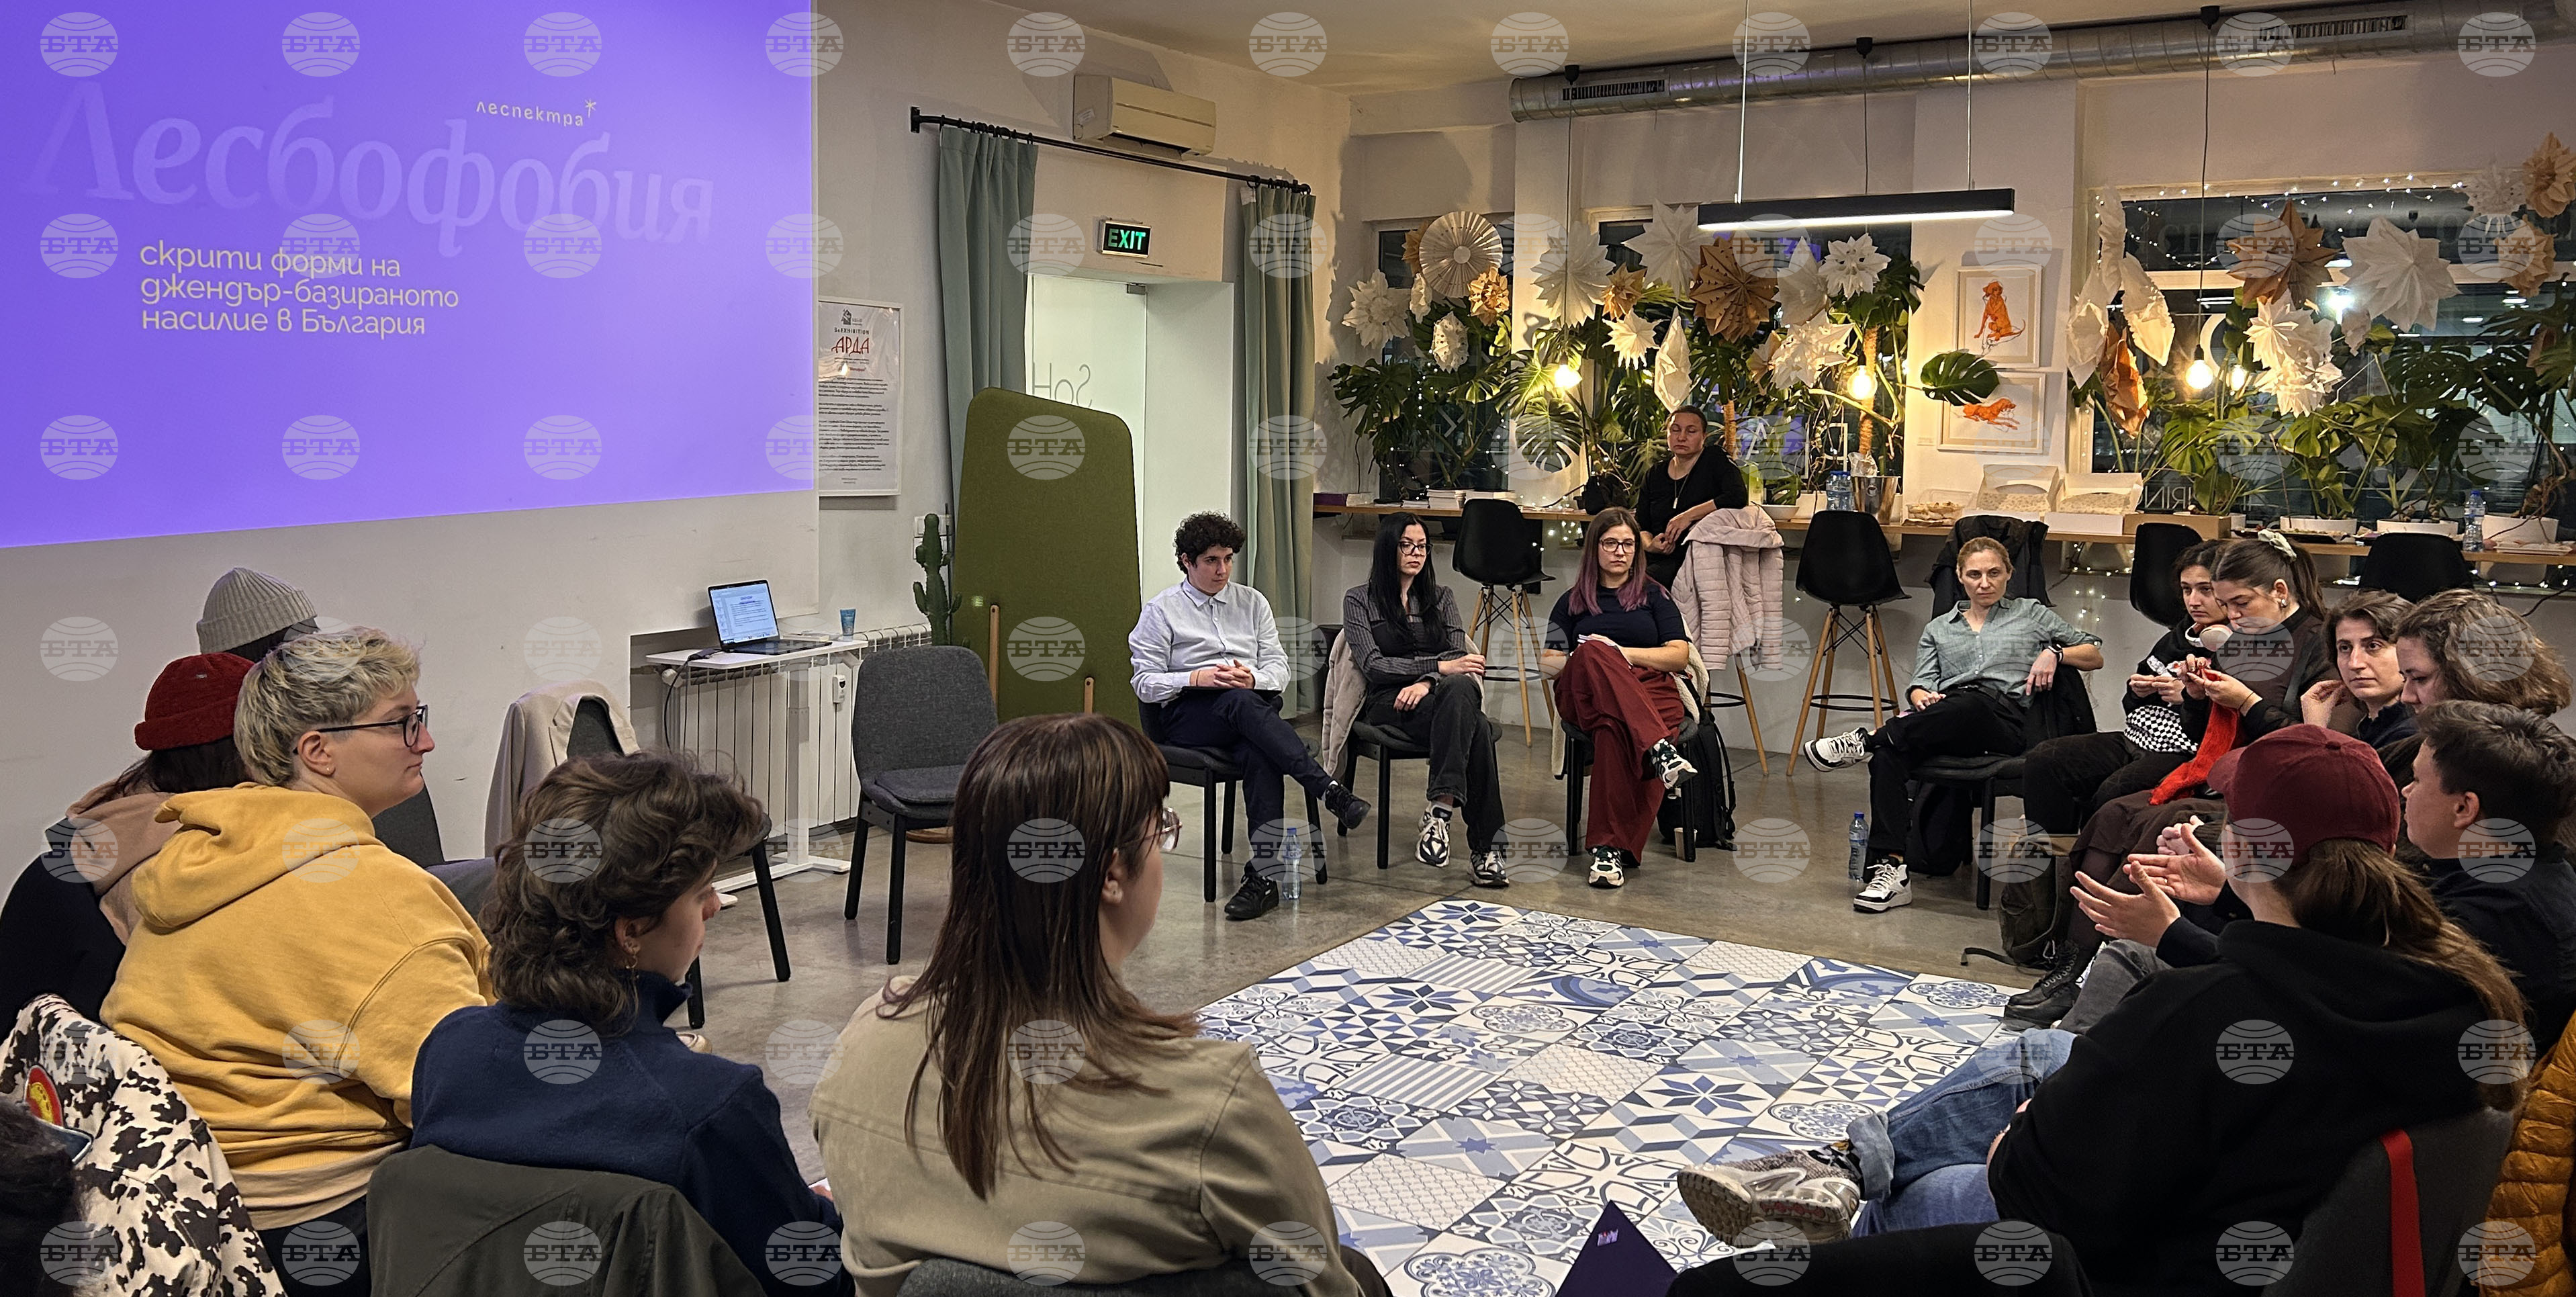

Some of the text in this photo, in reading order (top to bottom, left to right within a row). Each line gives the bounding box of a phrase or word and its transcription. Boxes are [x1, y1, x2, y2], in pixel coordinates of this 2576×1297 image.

[475, 101, 584, 127] леспектра
[17, 80, 714, 259] Лесбофобия
[1108, 228, 1146, 251] EXIT
[140, 240, 402, 279] скрити форми на
[140, 273, 459, 309] джендър-базираното
[142, 308, 426, 340] насилие в България
[831, 336, 870, 357] АРДА
